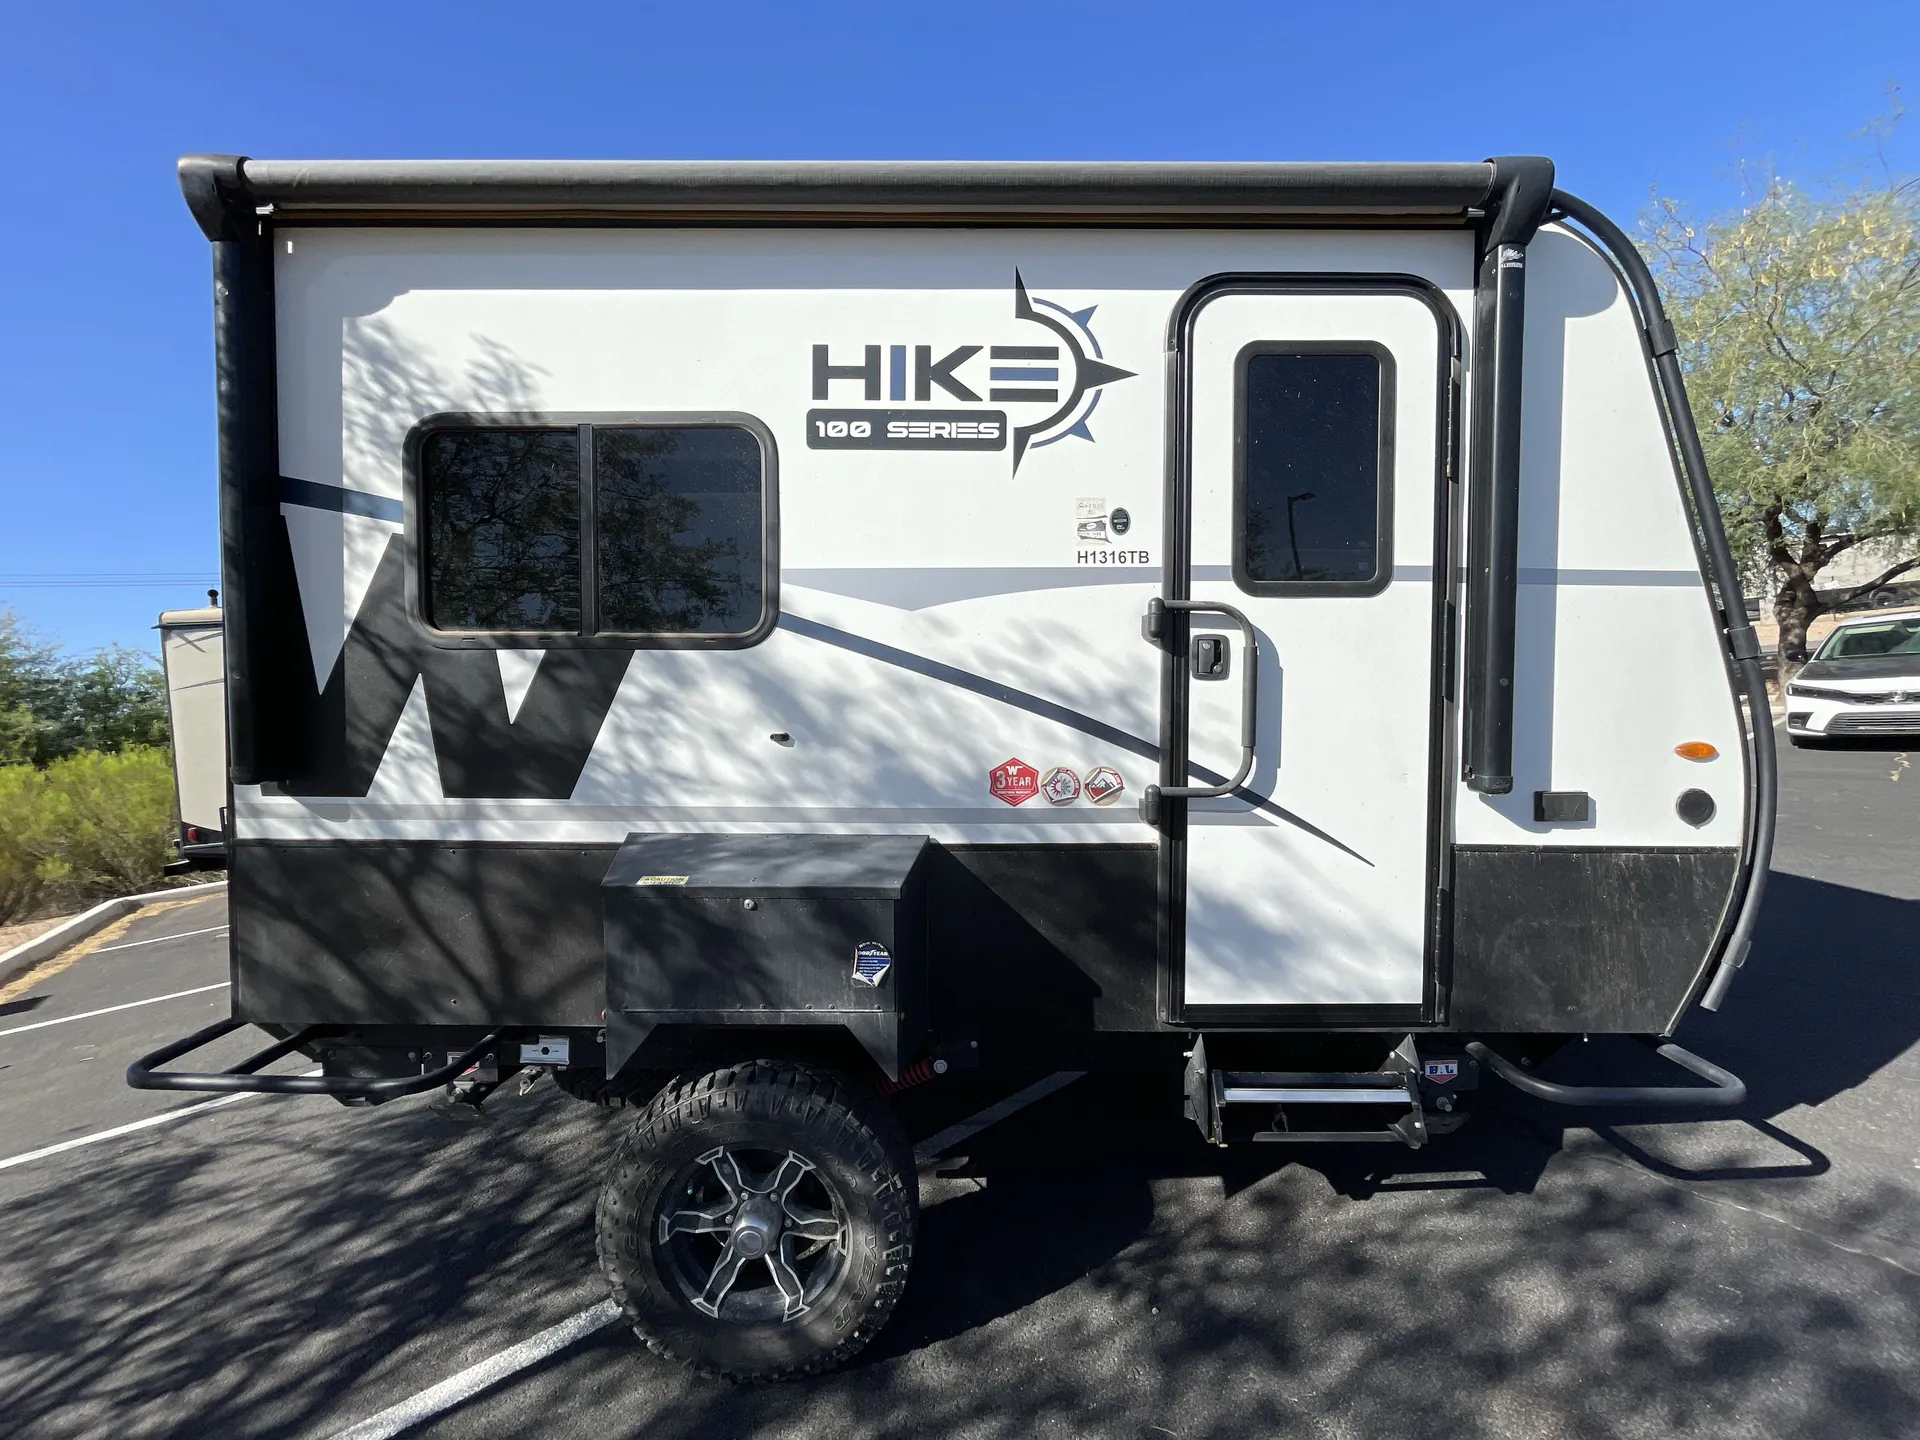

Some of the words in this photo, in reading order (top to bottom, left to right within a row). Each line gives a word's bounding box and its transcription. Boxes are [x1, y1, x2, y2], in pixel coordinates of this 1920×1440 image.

[812, 344, 1059, 402] HIKE
[815, 420, 872, 439] 100
[886, 421, 1000, 439] SERIES
[1077, 550, 1150, 564] H1316TB
[995, 770, 1006, 789] 3
[1007, 776, 1032, 787] YEAR
